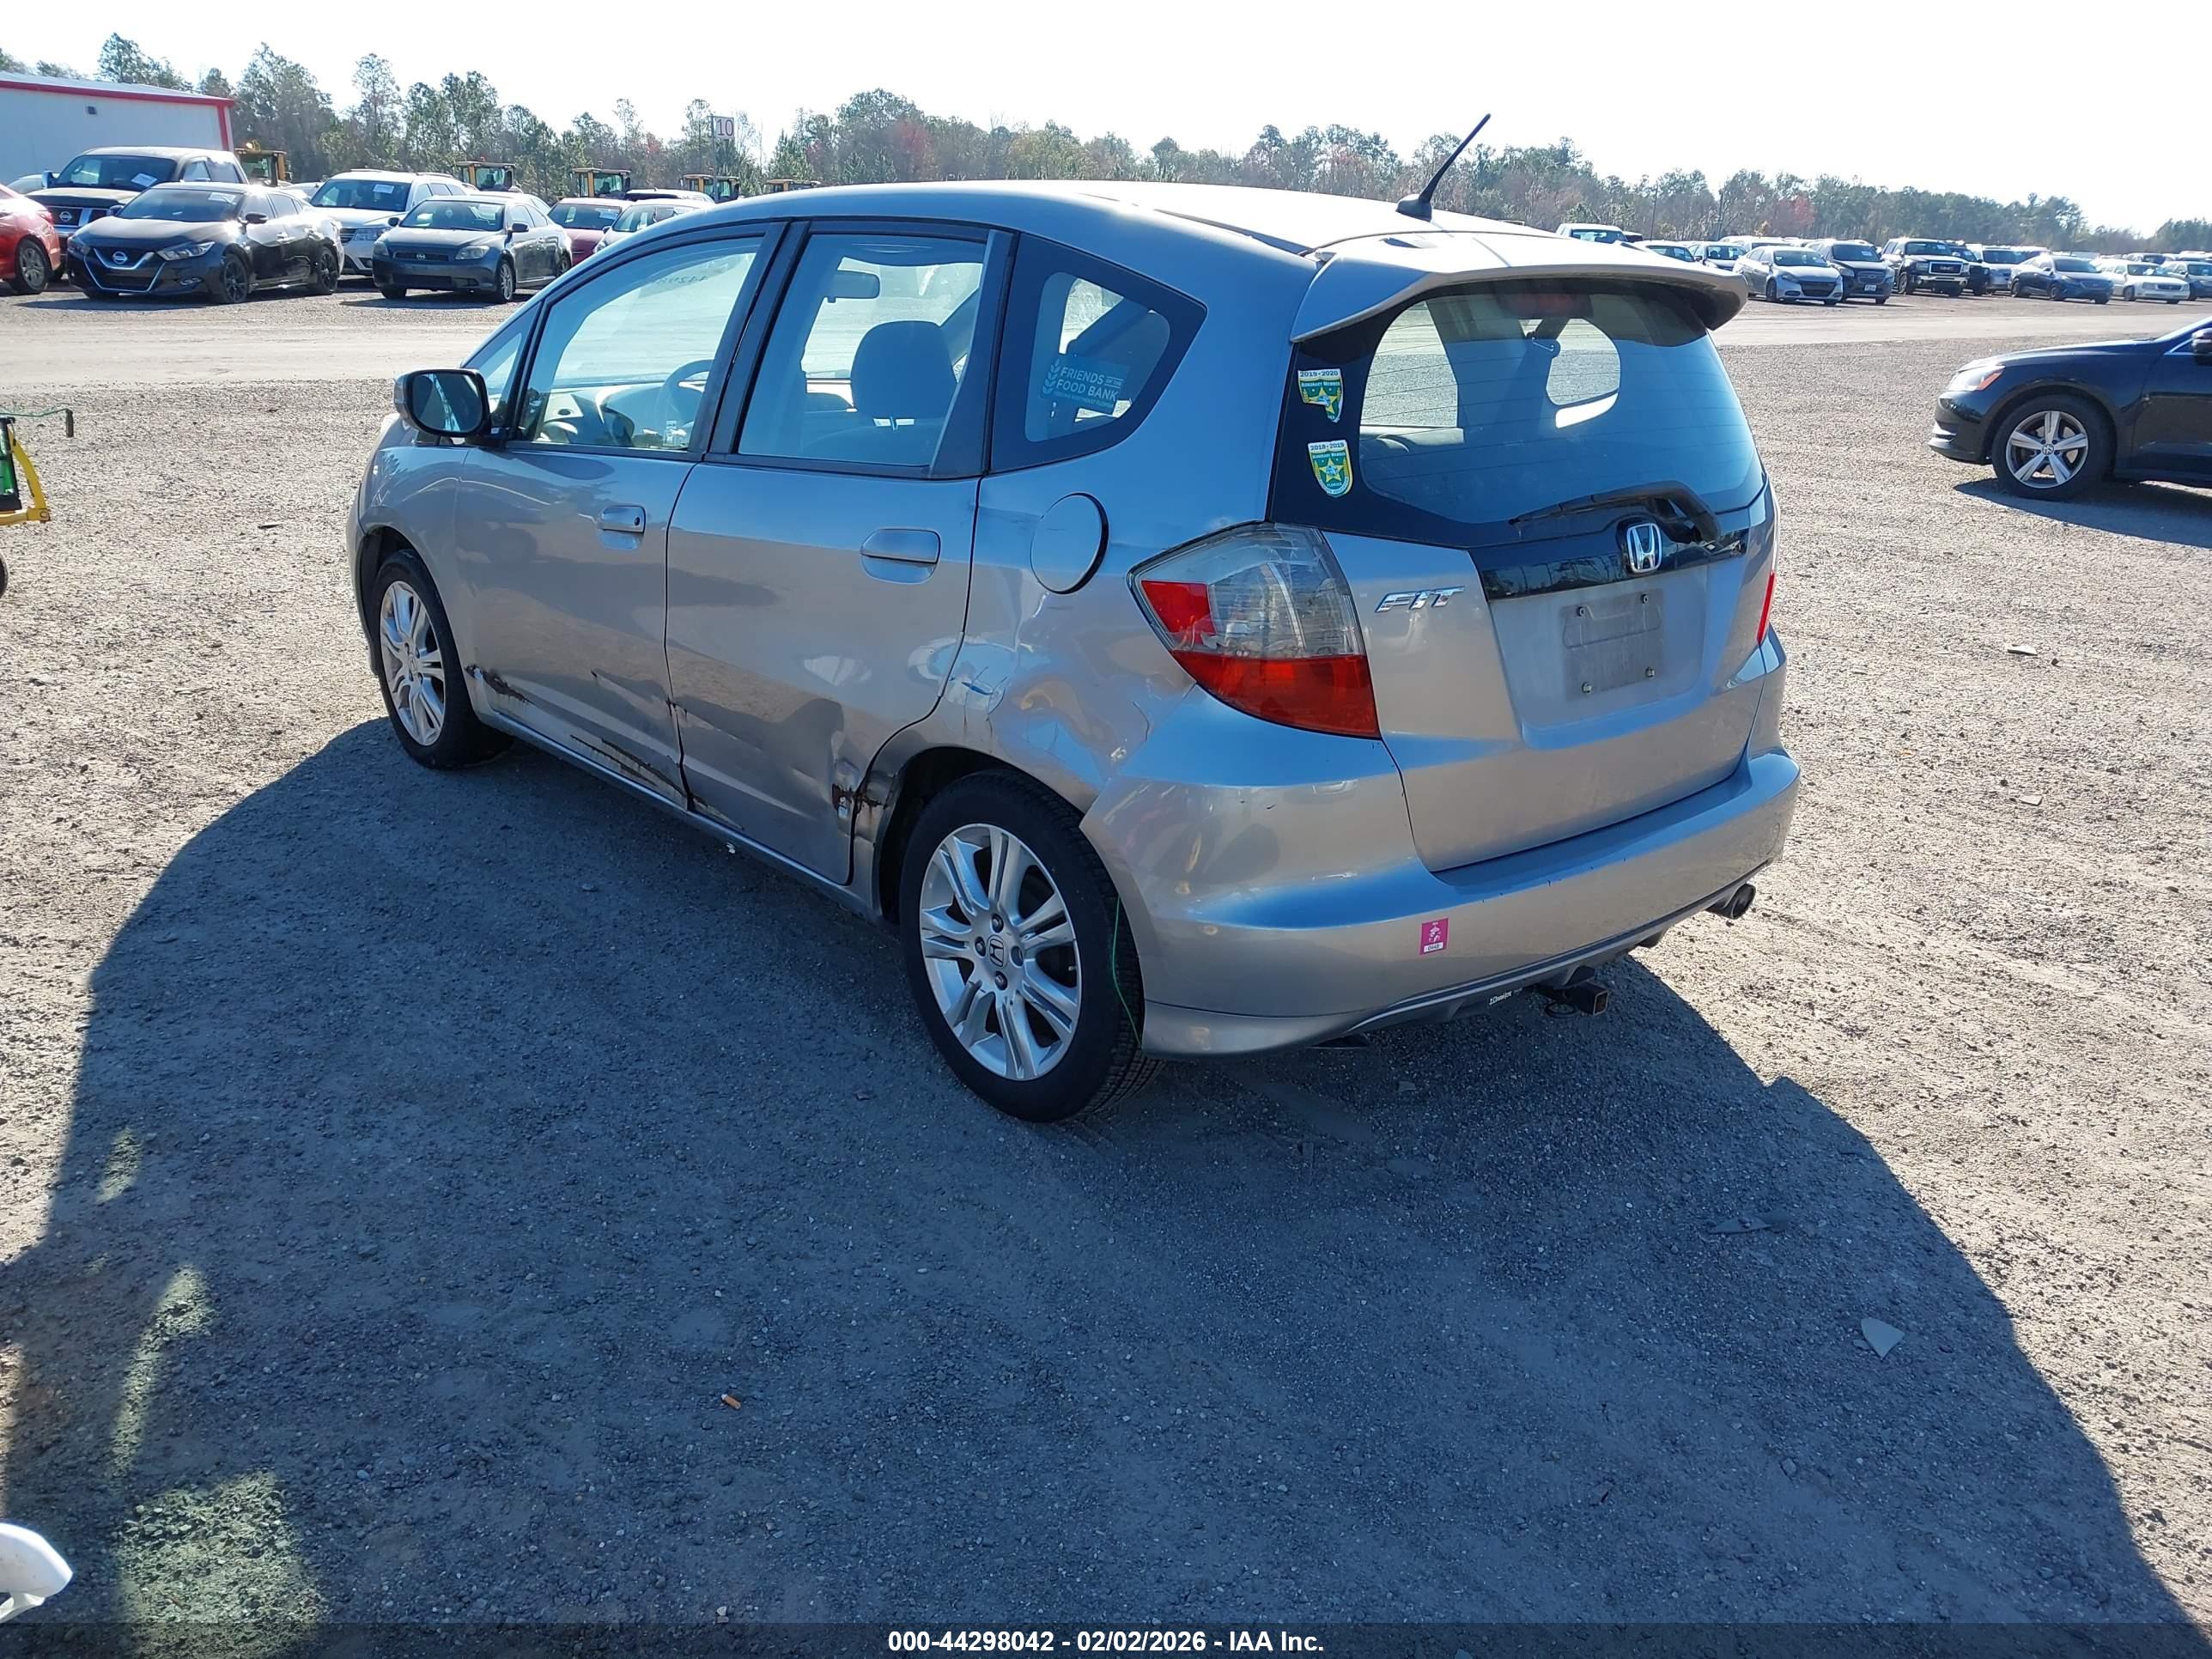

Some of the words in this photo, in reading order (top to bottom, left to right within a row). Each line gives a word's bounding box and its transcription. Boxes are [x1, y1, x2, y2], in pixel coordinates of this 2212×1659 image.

[716, 118, 734, 137] 10
[1060, 367, 1104, 384] FRIENDS
[1056, 379, 1086, 392] FOOD
[1087, 386, 1119, 402] BANK
[1374, 586, 1466, 613] FIT
